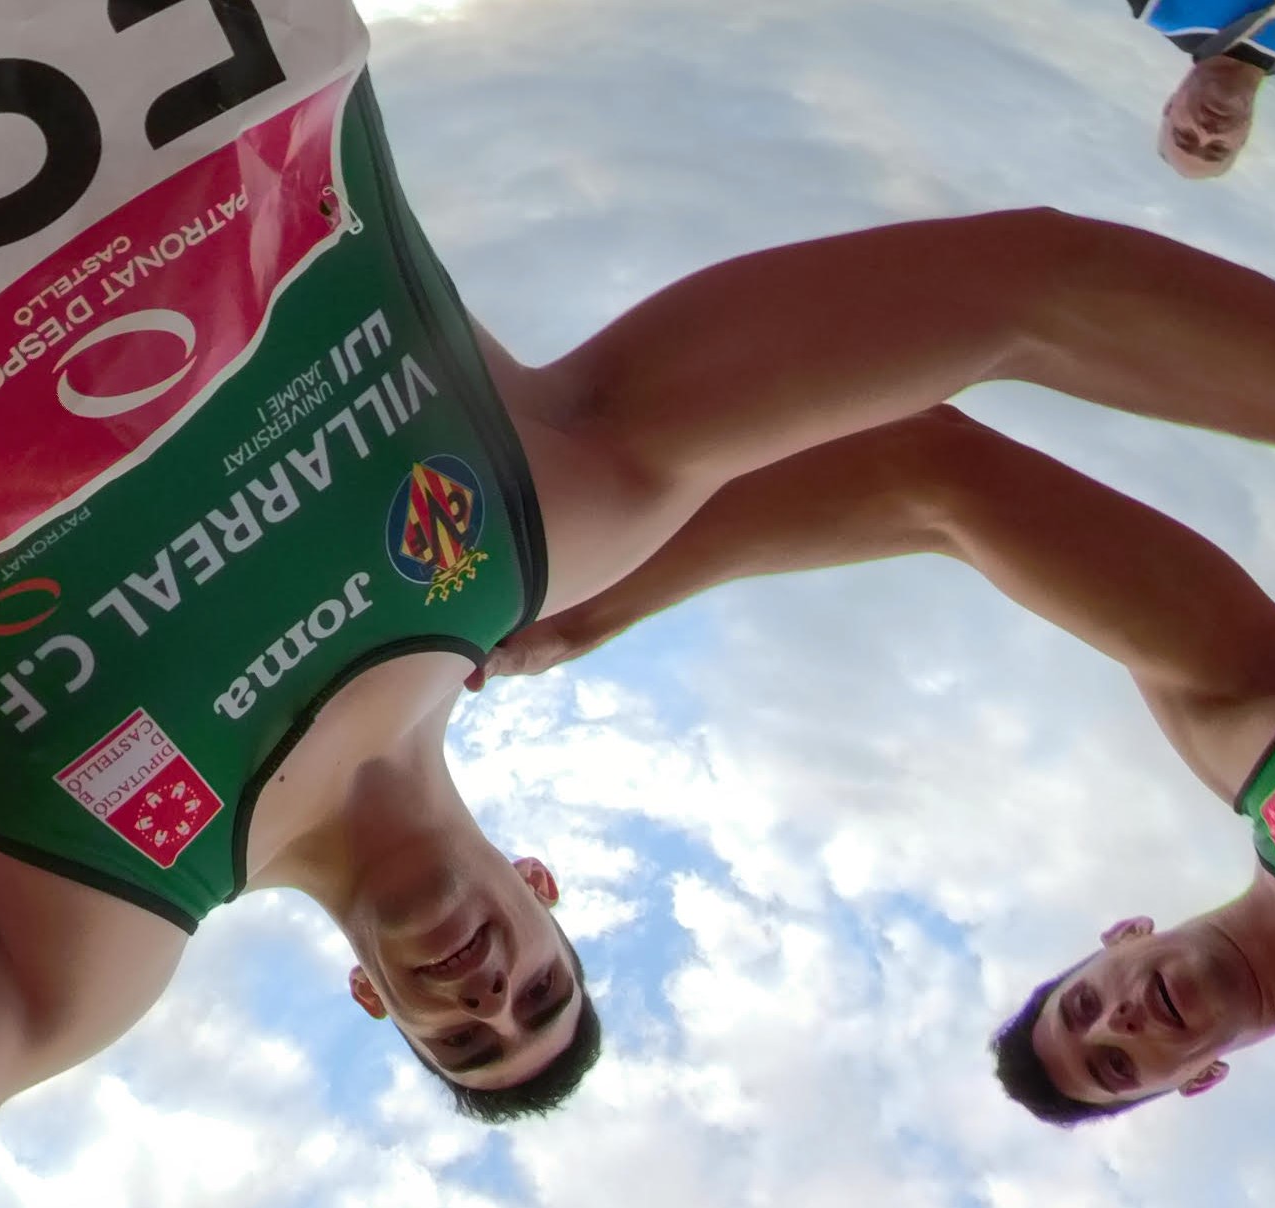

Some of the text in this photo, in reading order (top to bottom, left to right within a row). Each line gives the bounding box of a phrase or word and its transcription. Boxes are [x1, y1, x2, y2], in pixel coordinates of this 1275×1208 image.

[101, 186, 250, 306] PATRONAT
[223, 381, 334, 477] UNIVERSITAT
[266, 360, 322, 417] JAUME
[88, 353, 438, 637] VILLARREAL
[1, 506, 92, 582] PATRONAT
